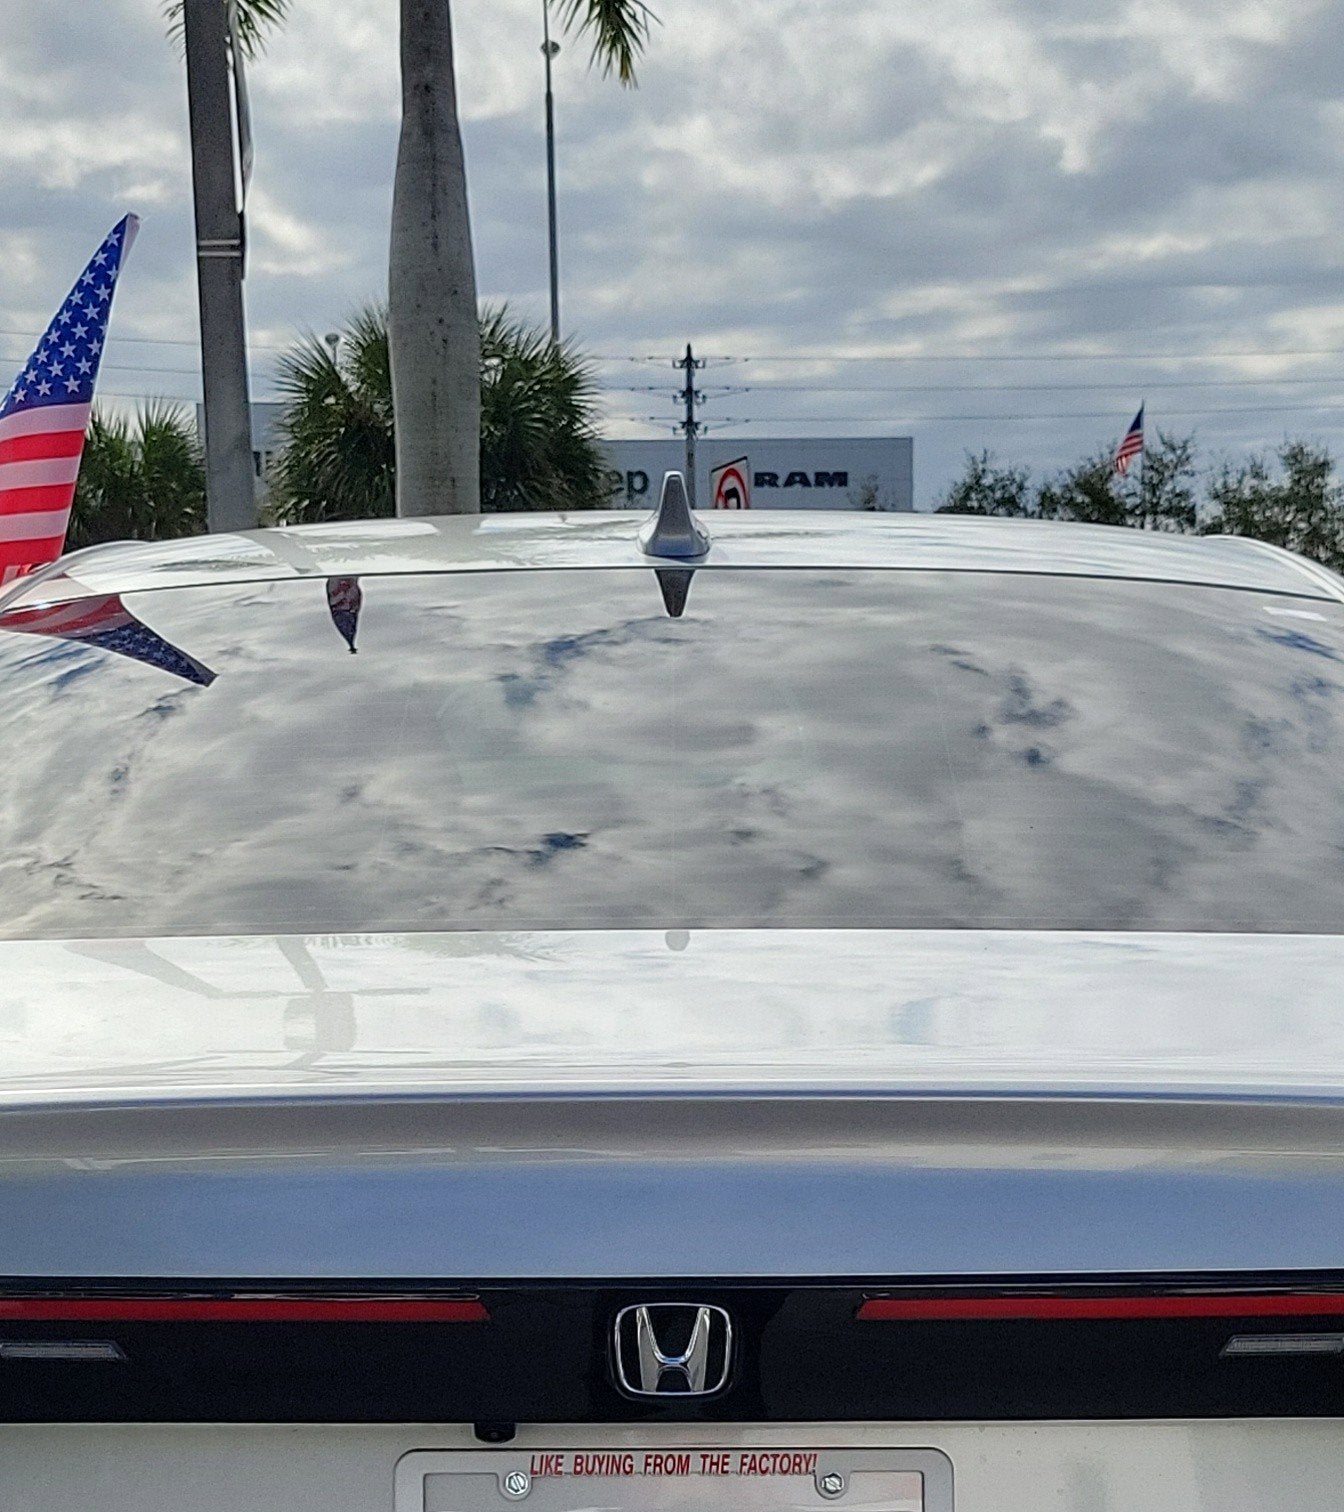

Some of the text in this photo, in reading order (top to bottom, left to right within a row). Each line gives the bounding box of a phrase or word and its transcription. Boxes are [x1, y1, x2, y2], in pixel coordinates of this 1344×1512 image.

[754, 471, 849, 488] RAM
[530, 1453, 818, 1476] LIKE BUYING FROM THE FACTORY!
